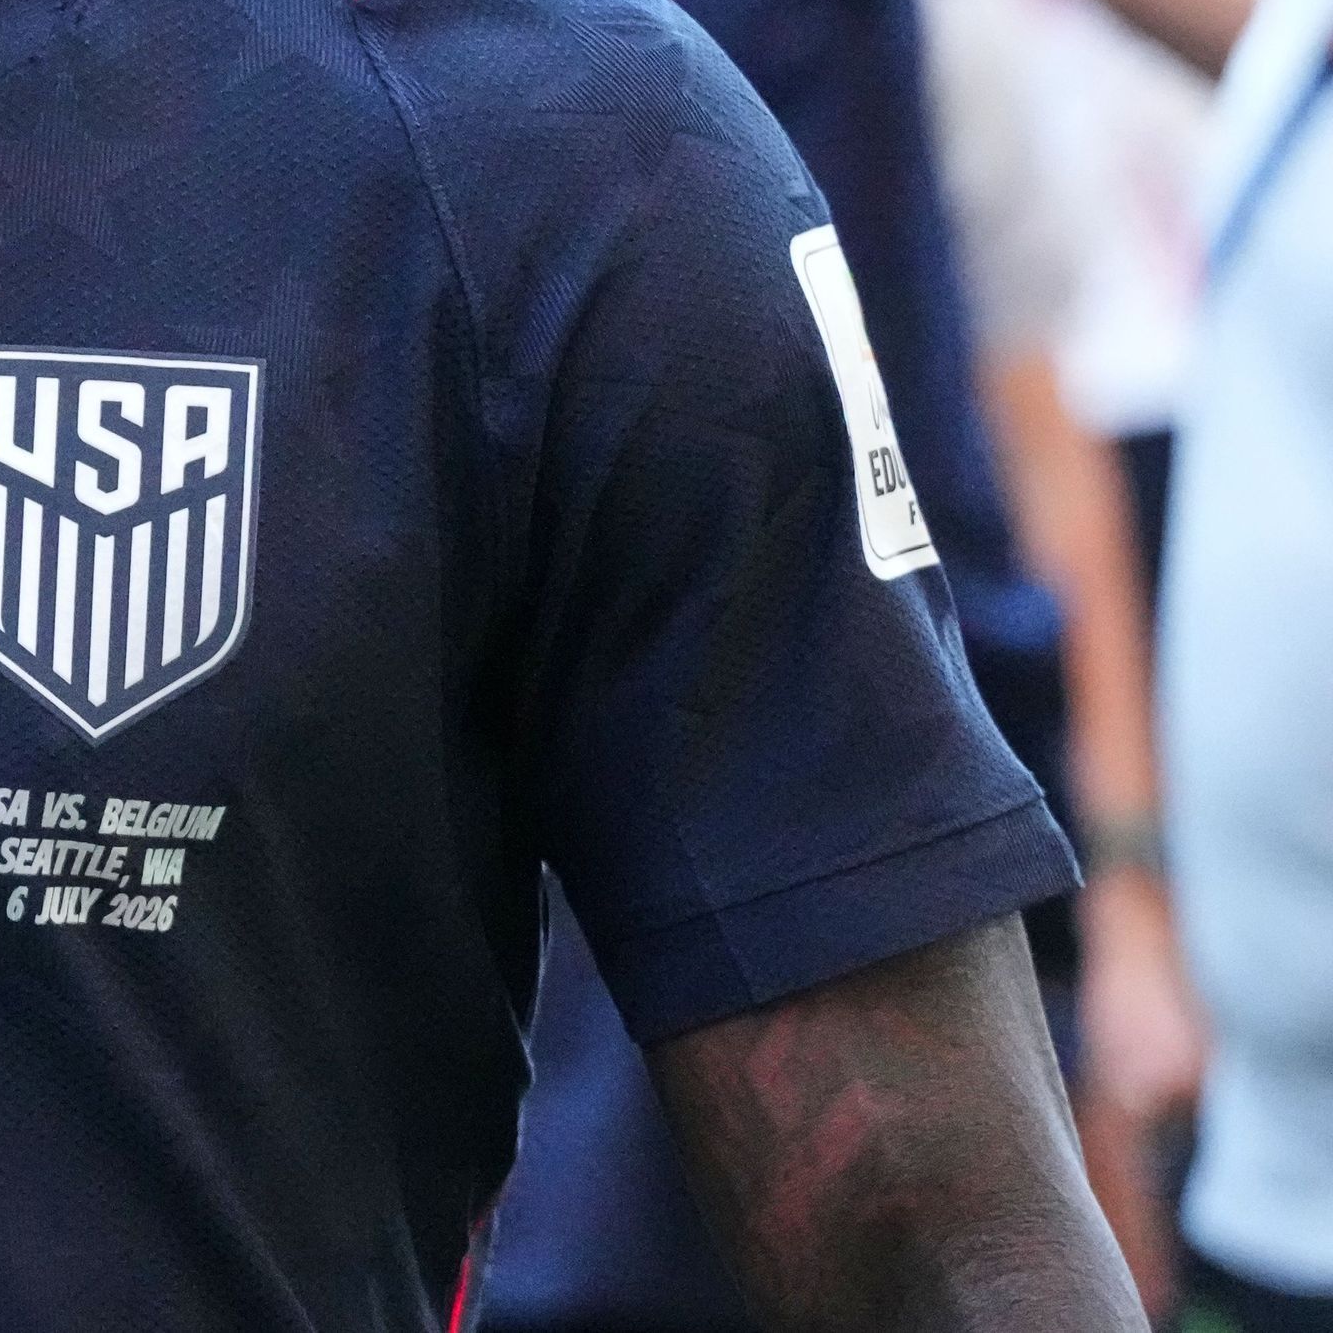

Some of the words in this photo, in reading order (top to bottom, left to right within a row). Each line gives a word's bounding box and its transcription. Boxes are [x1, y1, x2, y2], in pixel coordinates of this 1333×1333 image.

[40, 791, 88, 832] VS.
[99, 797, 227, 841] BELGIUM
[140, 847, 186, 886] WA
[6, 885, 29, 922] 6
[34, 886, 103, 925] JULY
[100, 893, 179, 932] 2026
